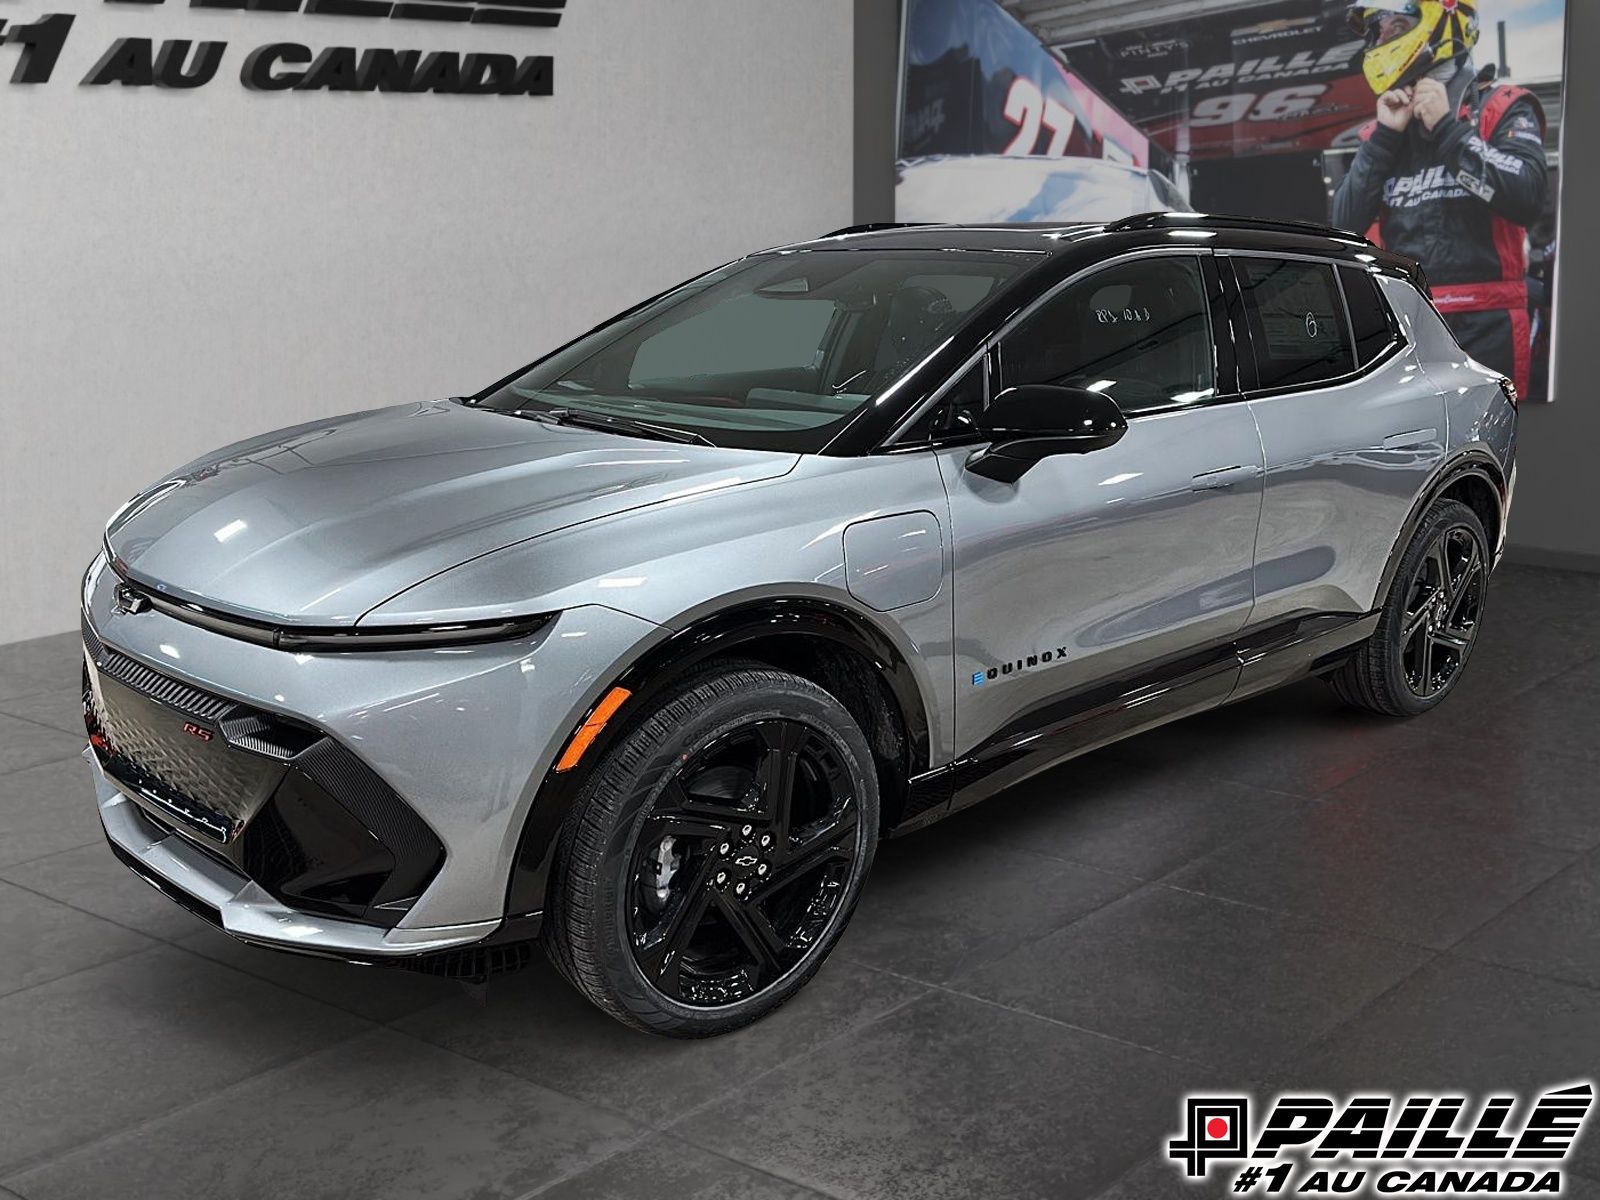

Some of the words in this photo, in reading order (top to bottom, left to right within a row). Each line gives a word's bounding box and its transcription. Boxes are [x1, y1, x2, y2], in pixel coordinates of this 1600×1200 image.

[1232, 25, 1323, 46] CHEVROLET
[79, 37, 228, 88] AU
[240, 42, 554, 96] CANADA
[1194, 78, 1230, 91] AU
[1237, 62, 1349, 84] CANADA
[1002, 76, 1075, 159] 27
[1190, 84, 1328, 127] 96
[1305, 311, 1318, 338] 6
[971, 646, 1067, 686] EQUINOX
[182, 721, 214, 743] RS
